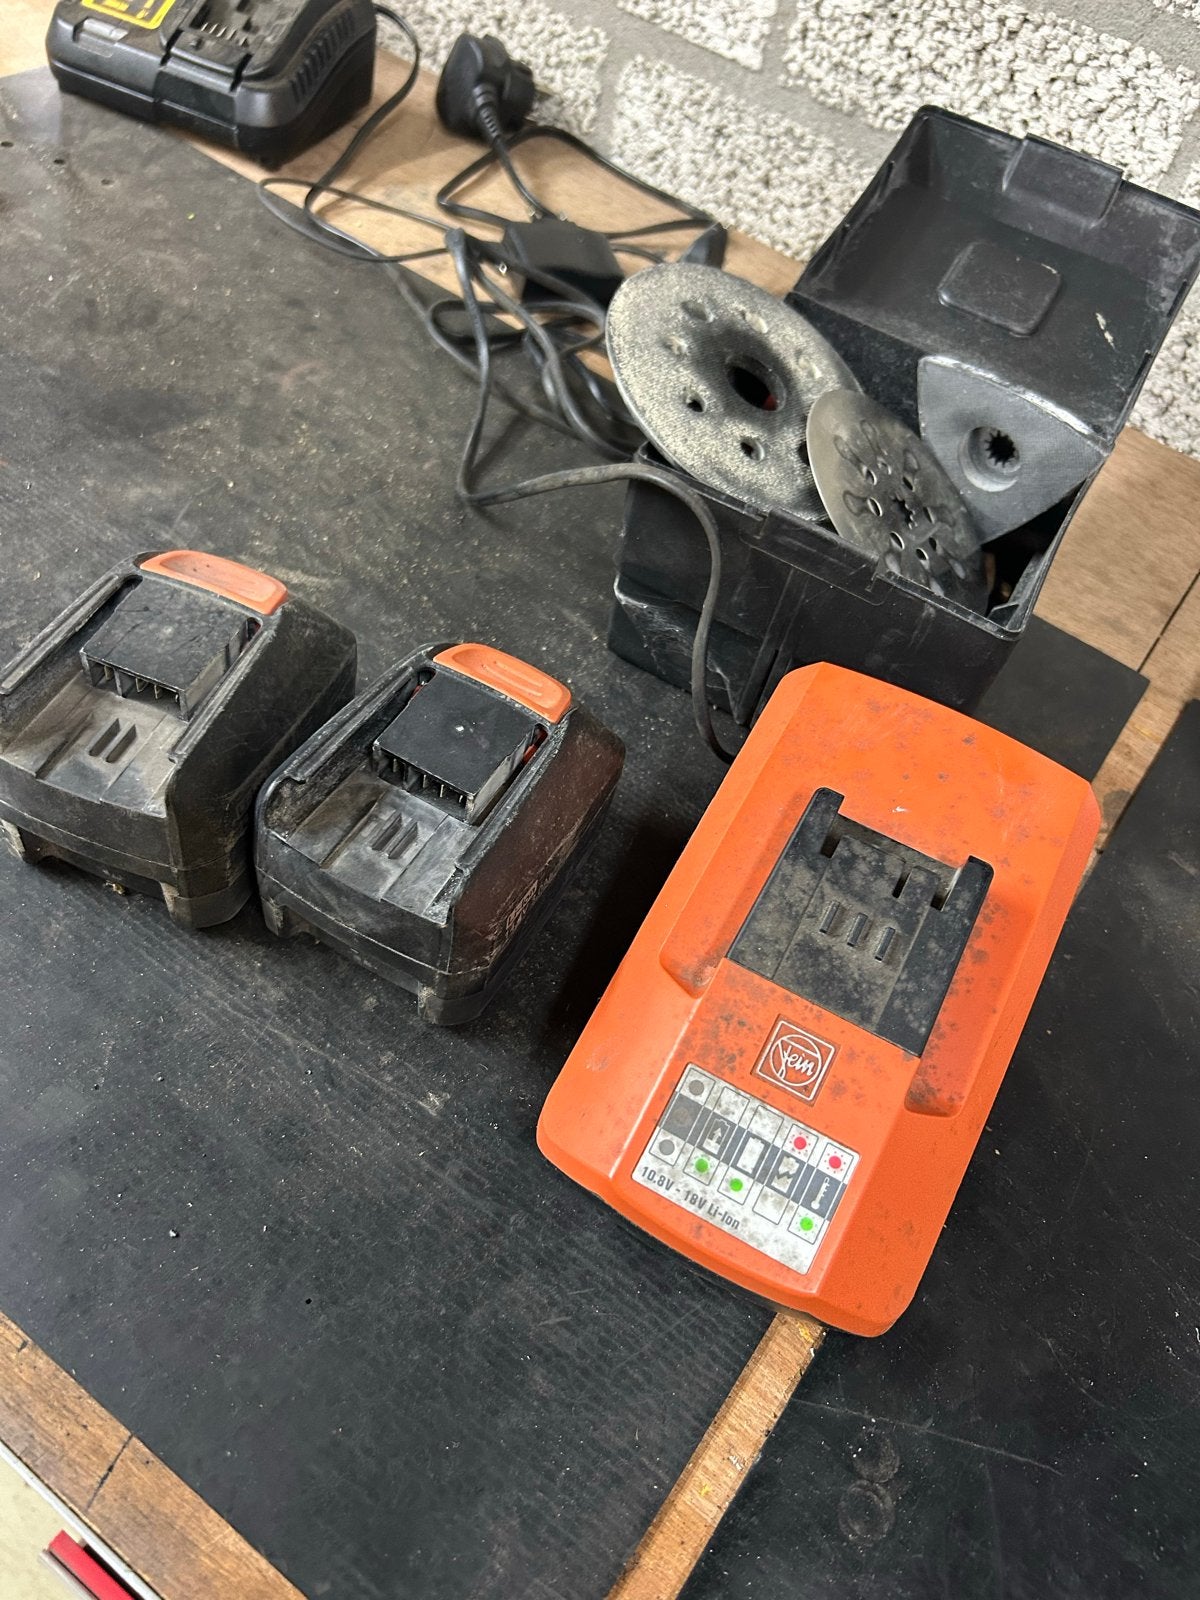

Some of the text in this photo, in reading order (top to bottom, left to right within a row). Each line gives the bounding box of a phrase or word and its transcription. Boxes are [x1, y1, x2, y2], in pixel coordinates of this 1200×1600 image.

[641, 1166, 674, 1192] 10.8V
[684, 1190, 707, 1210] 18V
[707, 1203, 740, 1230] Li-Ion
